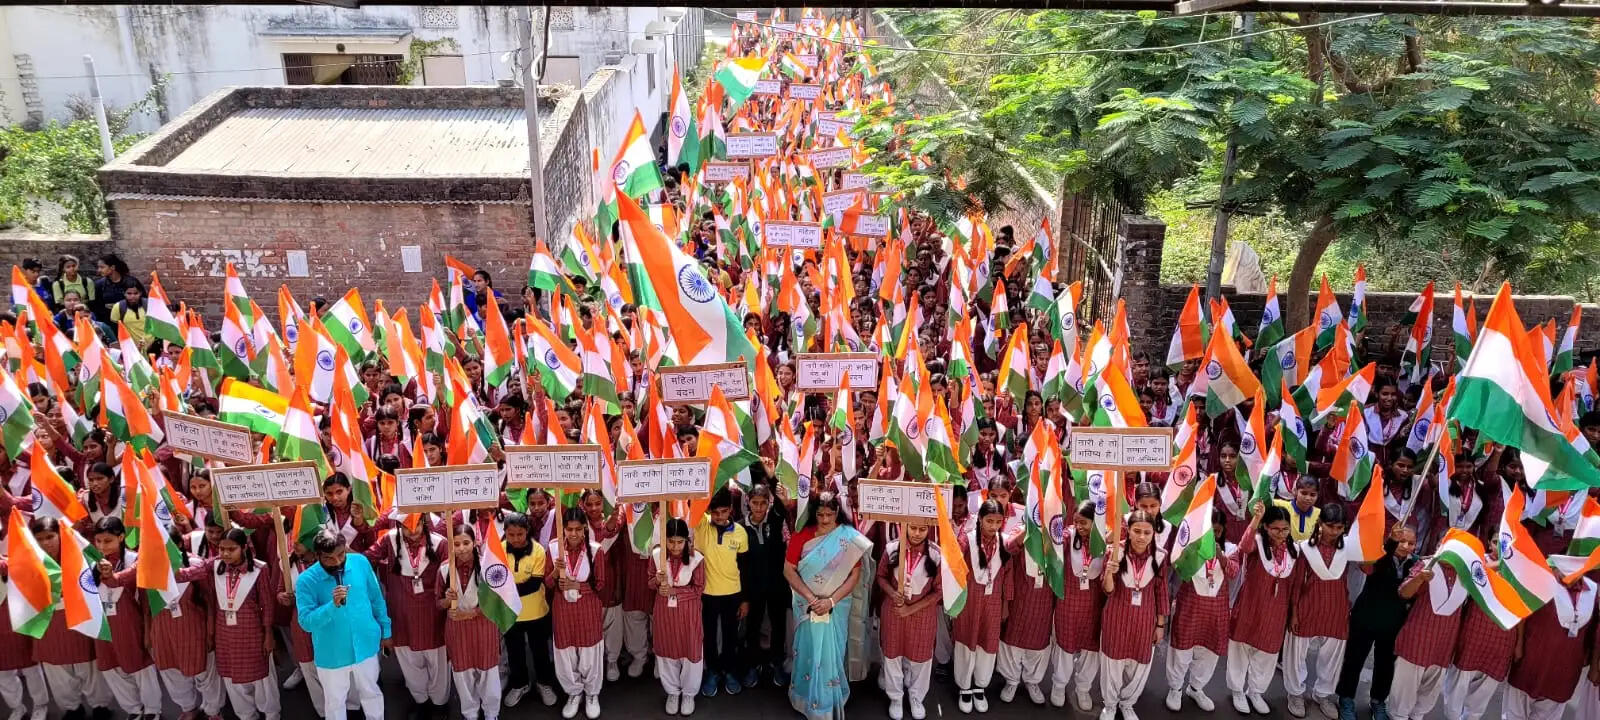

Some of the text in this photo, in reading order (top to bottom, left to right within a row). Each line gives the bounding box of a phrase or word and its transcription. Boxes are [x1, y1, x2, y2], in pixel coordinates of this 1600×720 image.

[671, 375, 697, 385] महिला
[676, 388, 695, 396] वंदन
[175, 423, 199, 435] महिला
[181, 436, 198, 447] वंदन
[1078, 437, 1093, 446] नारी
[1079, 449, 1100, 458] भविष्य
[624, 468, 661, 478] नारी शक्ति
[669, 468, 684, 476] नारी
[454, 476, 470, 485] नारी
[669, 478, 691, 487] भविष्य
[455, 488, 477, 496] भविष्य
[916, 490, 937, 500] महि
